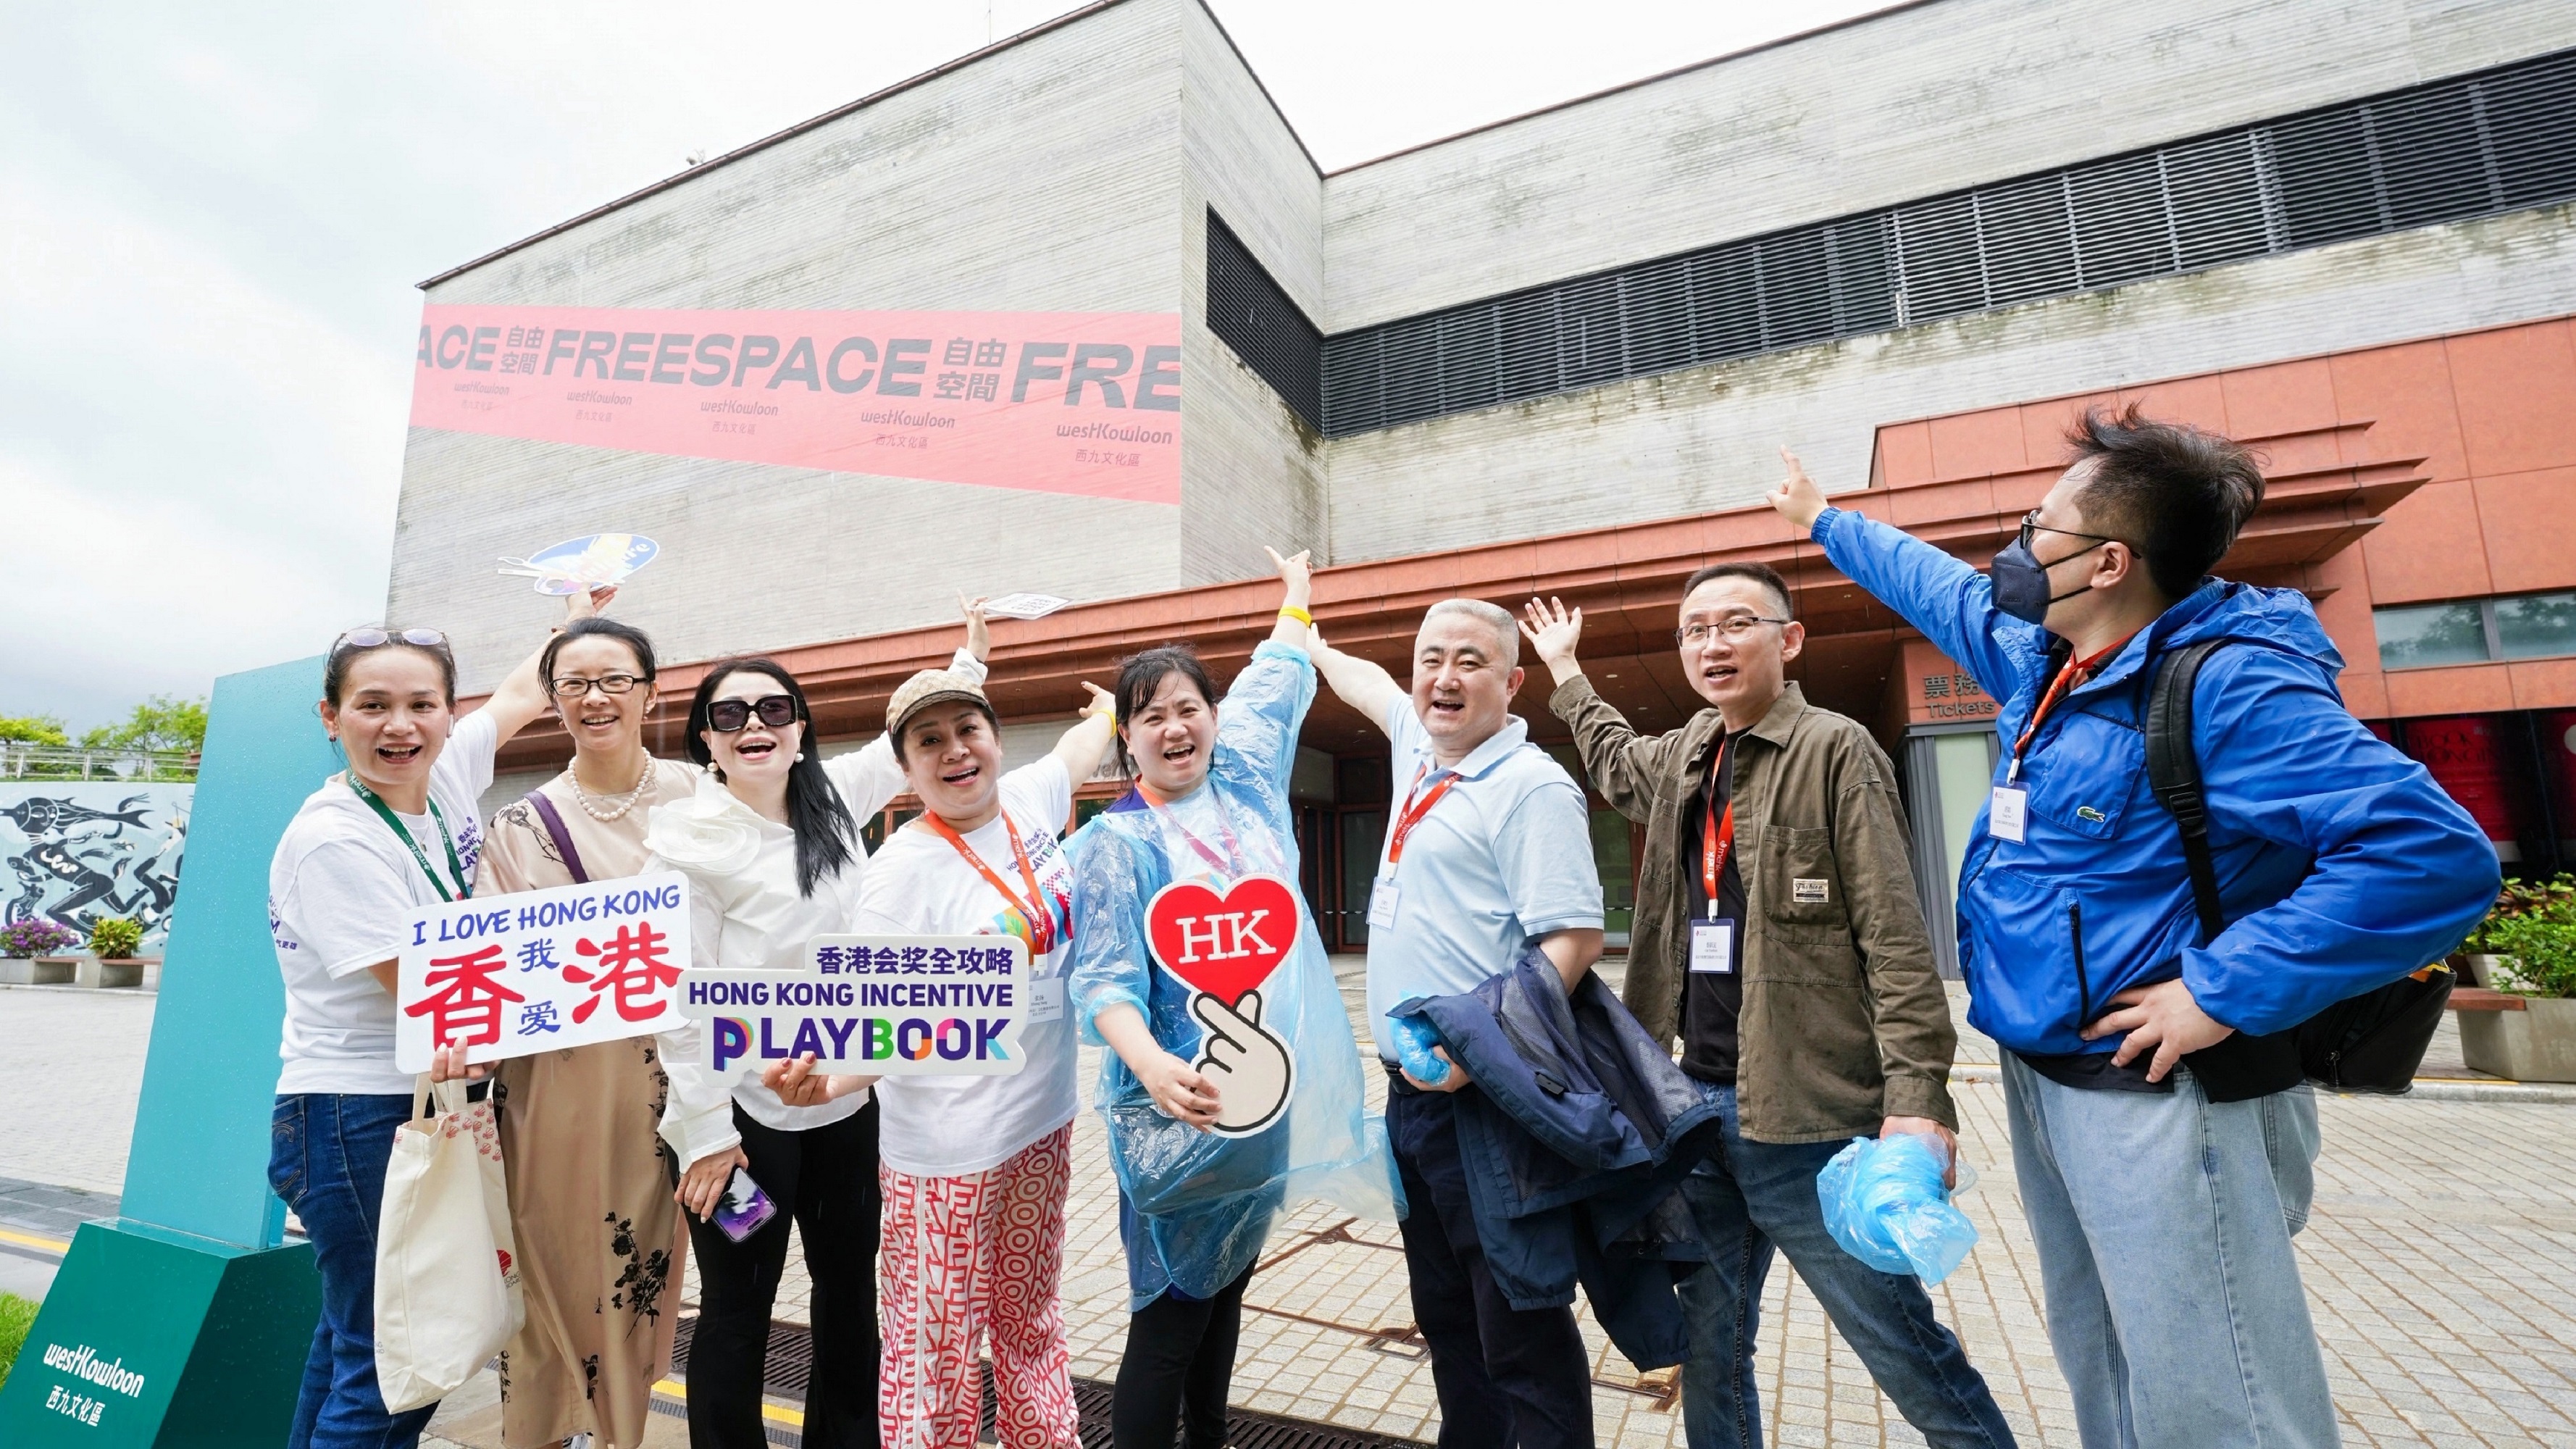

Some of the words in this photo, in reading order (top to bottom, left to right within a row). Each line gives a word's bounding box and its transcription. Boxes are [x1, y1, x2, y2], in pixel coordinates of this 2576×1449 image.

[417, 325, 501, 372] ACE
[506, 325, 545, 350] 自由
[498, 351, 538, 376] 空間
[543, 329, 932, 398] FREESPACE
[943, 337, 1008, 368] 自由
[933, 370, 1001, 403] 空間
[1010, 341, 1181, 413] FRE
[566, 389, 633, 407] westKowloon
[701, 400, 779, 417] westKowloon
[711, 420, 757, 436] 西九文化區
[861, 409, 955, 429] westKowloon
[874, 433, 929, 450] 西九文化區
[1056, 422, 1173, 446] westKowloon
[1075, 448, 1142, 467] 西九文化區
[1924, 673, 1981, 699] 票務
[1926, 701, 1995, 718] Tickets
[349, 772, 367, 793] mehk
[438, 820, 449, 845] mehk
[1397, 822, 1413, 840] mehk
[409, 843, 427, 865] mehk
[963, 848, 982, 867] mehk
[1012, 839, 1023, 859] mehk
[1715, 848, 1724, 872] mehk
[1705, 851, 1715, 875] mehk
[411, 920, 427, 946] I
[438, 909, 511, 942] LOVE
[517, 896, 598, 930] HONG
[603, 885, 681, 918] KONG
[1025, 908, 1040, 930] mehk
[1175, 909, 1277, 964] HK
[517, 938, 560, 973] 我
[816, 946, 1013, 975] 香港会奖全攻略
[403, 944, 525, 1052] 香
[561, 921, 685, 1024] 港
[689, 982, 769, 1006] HONG
[776, 982, 854, 1006] KONG
[861, 983, 1013, 1007] INCENTIVE
[517, 1000, 561, 1035] 爱
[713, 1016, 1011, 1072] PLAYBOOK
[43, 1342, 145, 1398] westKowloon
[46, 1385, 106, 1427] 西九文化區
